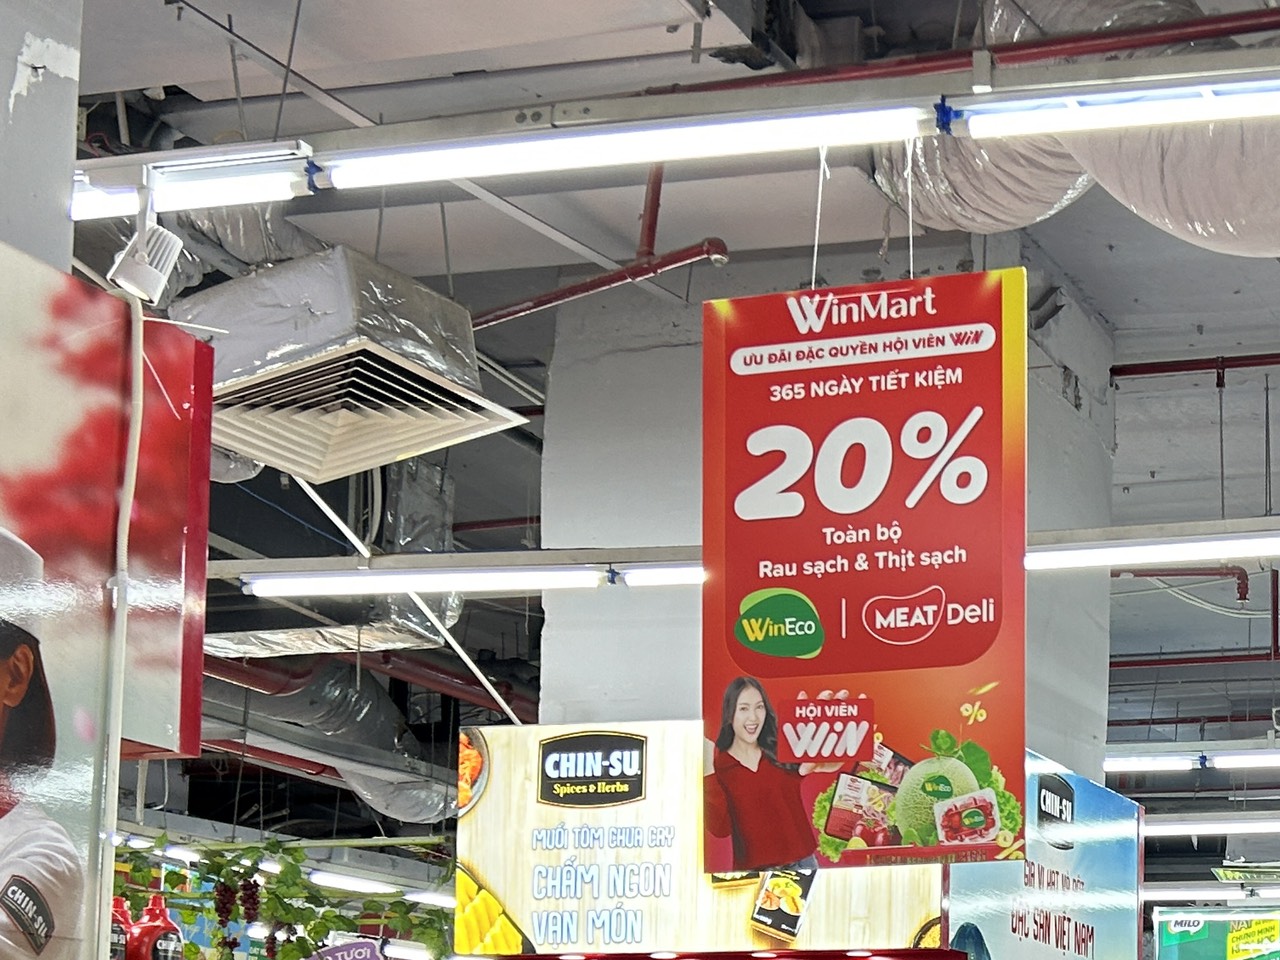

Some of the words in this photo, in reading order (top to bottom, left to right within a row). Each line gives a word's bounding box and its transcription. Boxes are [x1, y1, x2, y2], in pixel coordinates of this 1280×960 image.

[786, 287, 938, 335] WinMart
[743, 354, 763, 367] ƯU
[768, 350, 791, 366] ĐÃI
[795, 346, 825, 364] ĐẶC
[829, 340, 879, 359] QUYỀN
[882, 337, 909, 354] HỘI
[912, 333, 945, 350] VIÊN
[769, 385, 806, 402] 365
[810, 374, 864, 398] NGÀY
[869, 368, 909, 393] TIẾT
[915, 364, 963, 390] KIỆM
[734, 405, 989, 521] 20%
[822, 525, 870, 545] Toàn
[876, 521, 902, 544] bộ
[758, 560, 797, 578] Rau
[802, 554, 849, 579] sạch
[854, 553, 869, 571] &
[875, 549, 914, 571] Thịt
[919, 545, 967, 569] sạch
[742, 617, 816, 642] WinEco
[874, 605, 938, 629] MEAT
[946, 598, 995, 626] Deli
[795, 703, 821, 718] HỘI
[824, 702, 858, 717] VIÊN
[544, 750, 641, 778] CHIN-SU
[552, 782, 588, 798] Spices
[597, 781, 630, 794] Herbs
[1040, 788, 1073, 824] CHIN-SU
[531, 822, 568, 851] MUỐI
[573, 824, 604, 849] TÔM
[608, 827, 644, 849] CHUA
[647, 825, 676, 849] CAY
[532, 856, 599, 900] CHẤM
[608, 863, 672, 898] NGON
[531, 911, 578, 949] VẠN
[586, 902, 643, 944] MÓN
[1173, 919, 1201, 929] MILO
[1257, 925, 1276, 937] MINH
[1074, 921, 1095, 960] NAM
